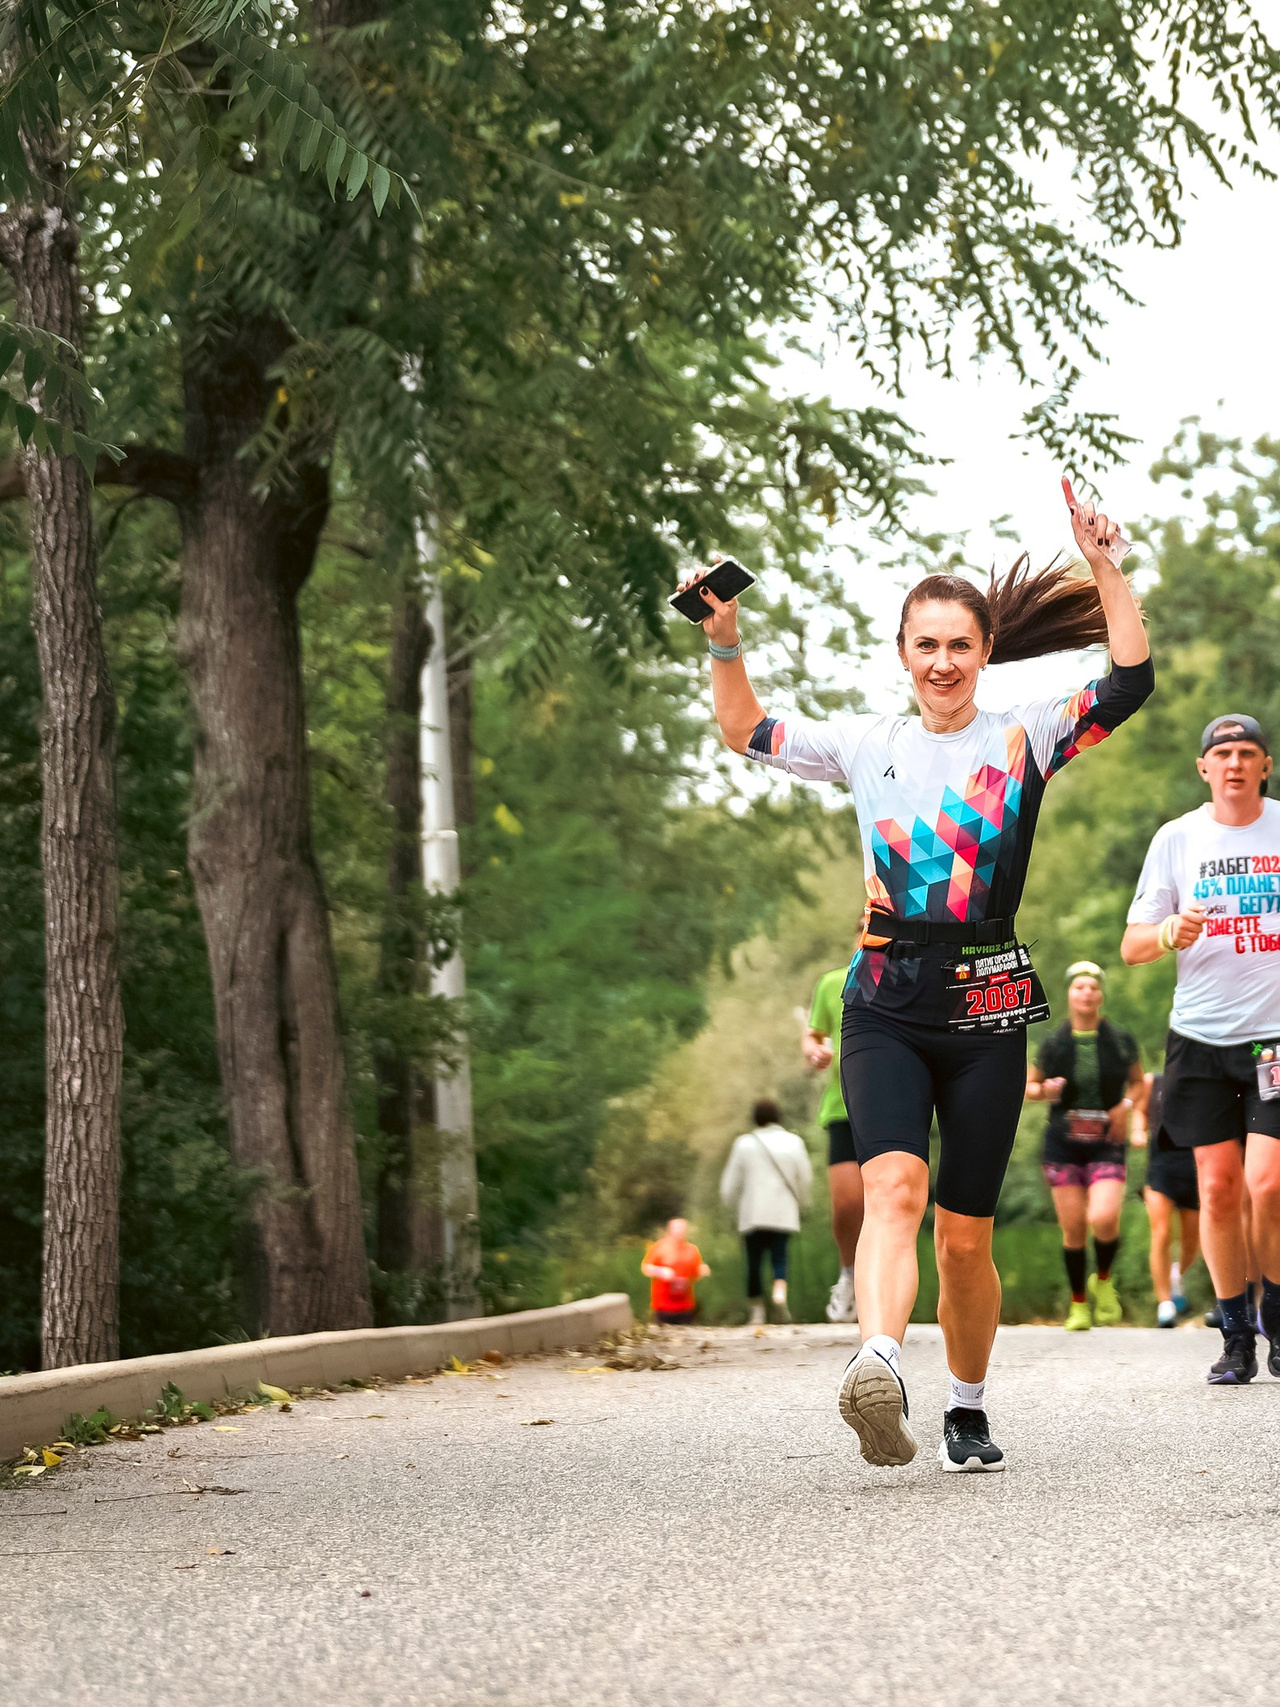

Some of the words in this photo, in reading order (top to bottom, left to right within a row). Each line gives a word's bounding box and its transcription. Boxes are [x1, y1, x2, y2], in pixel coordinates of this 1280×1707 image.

[1193, 877, 1223, 900] 45%
[1206, 915, 1261, 937] ВМЕСТЕ
[1235, 935, 1246, 954] С
[975, 949, 1017, 969] ПЯТИГОРСКИЙ
[976, 960, 1019, 977] ПОЛУМАРАФОН
[966, 978, 1032, 1016] 2087
[980, 1007, 1027, 1021] ПОЛУМАРАФОН
